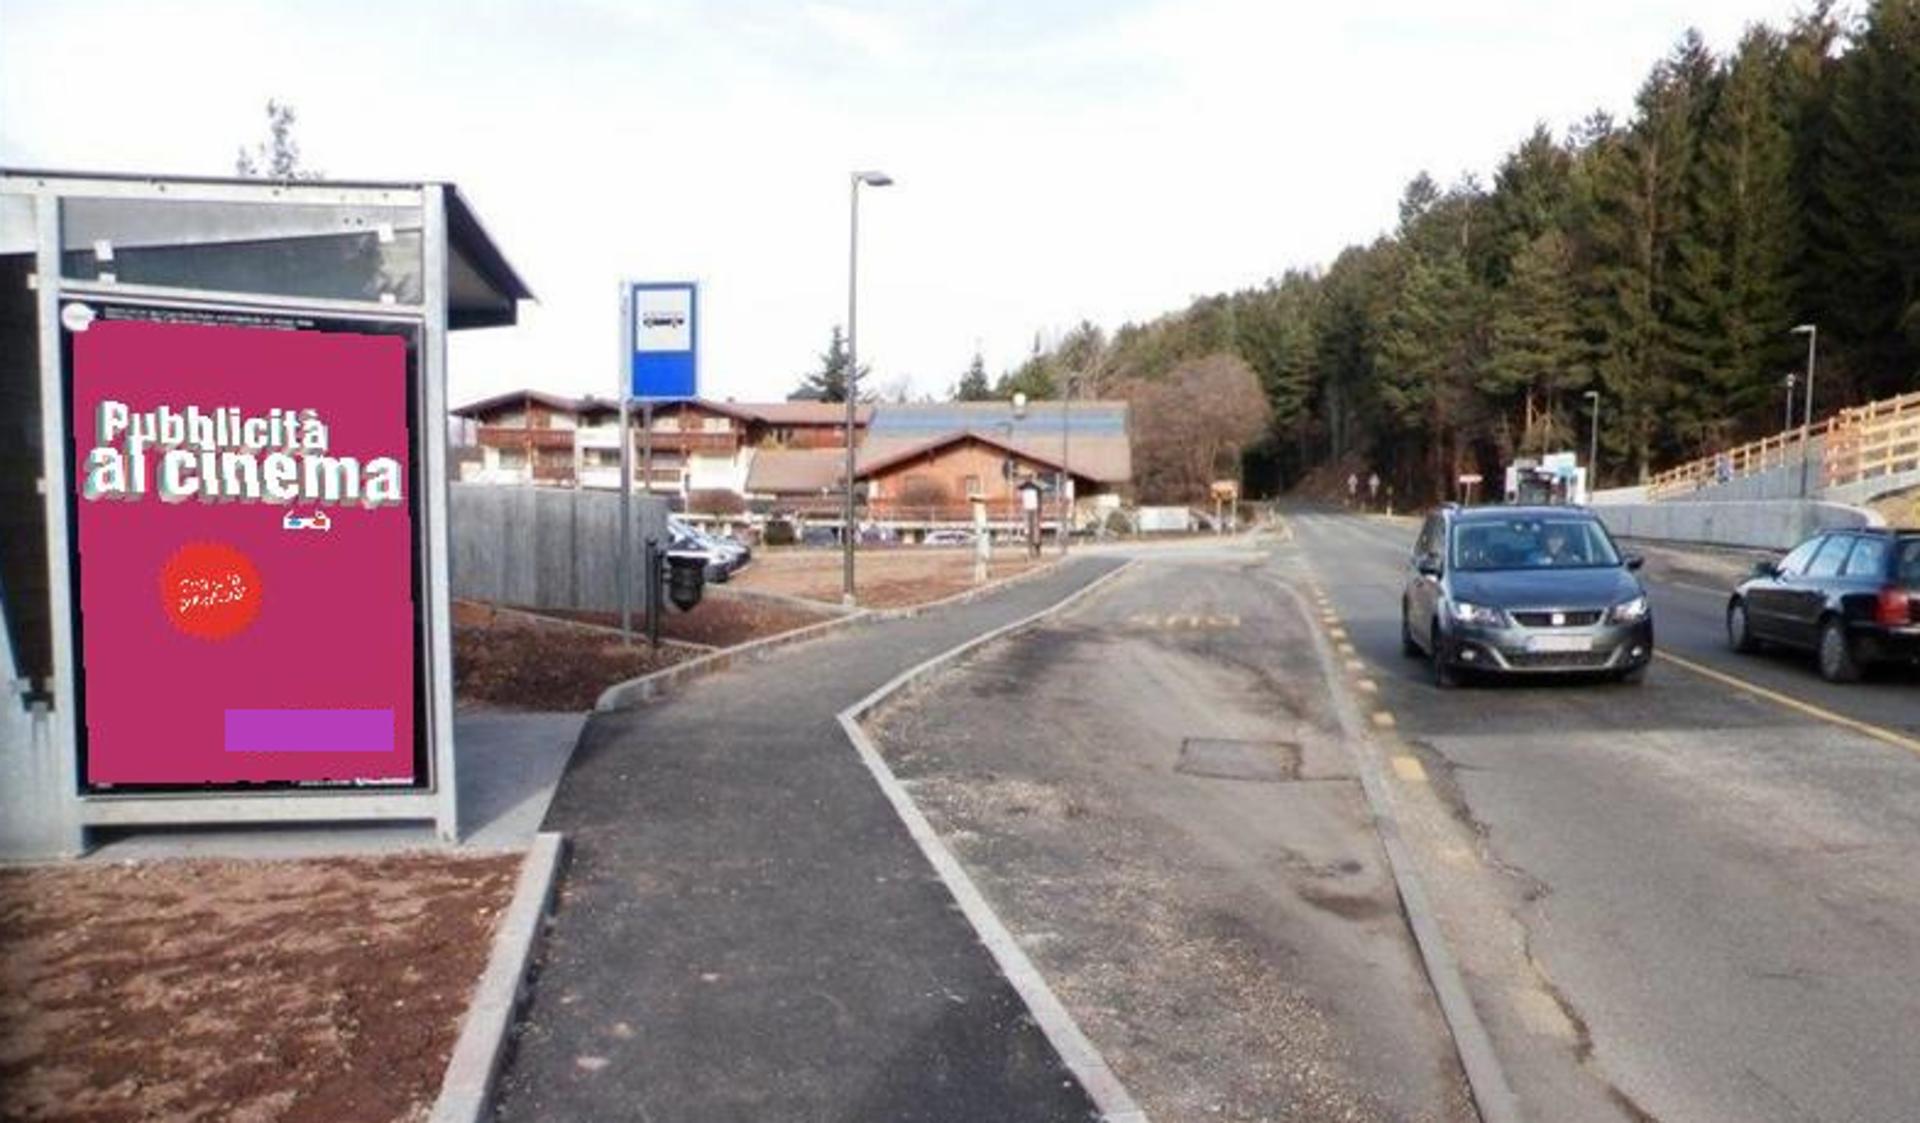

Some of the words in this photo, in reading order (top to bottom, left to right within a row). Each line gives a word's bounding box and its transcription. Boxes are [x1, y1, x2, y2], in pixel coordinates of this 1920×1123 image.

[98, 400, 328, 449] Pubblicità
[85, 435, 148, 500] al
[159, 449, 402, 505] cinema
